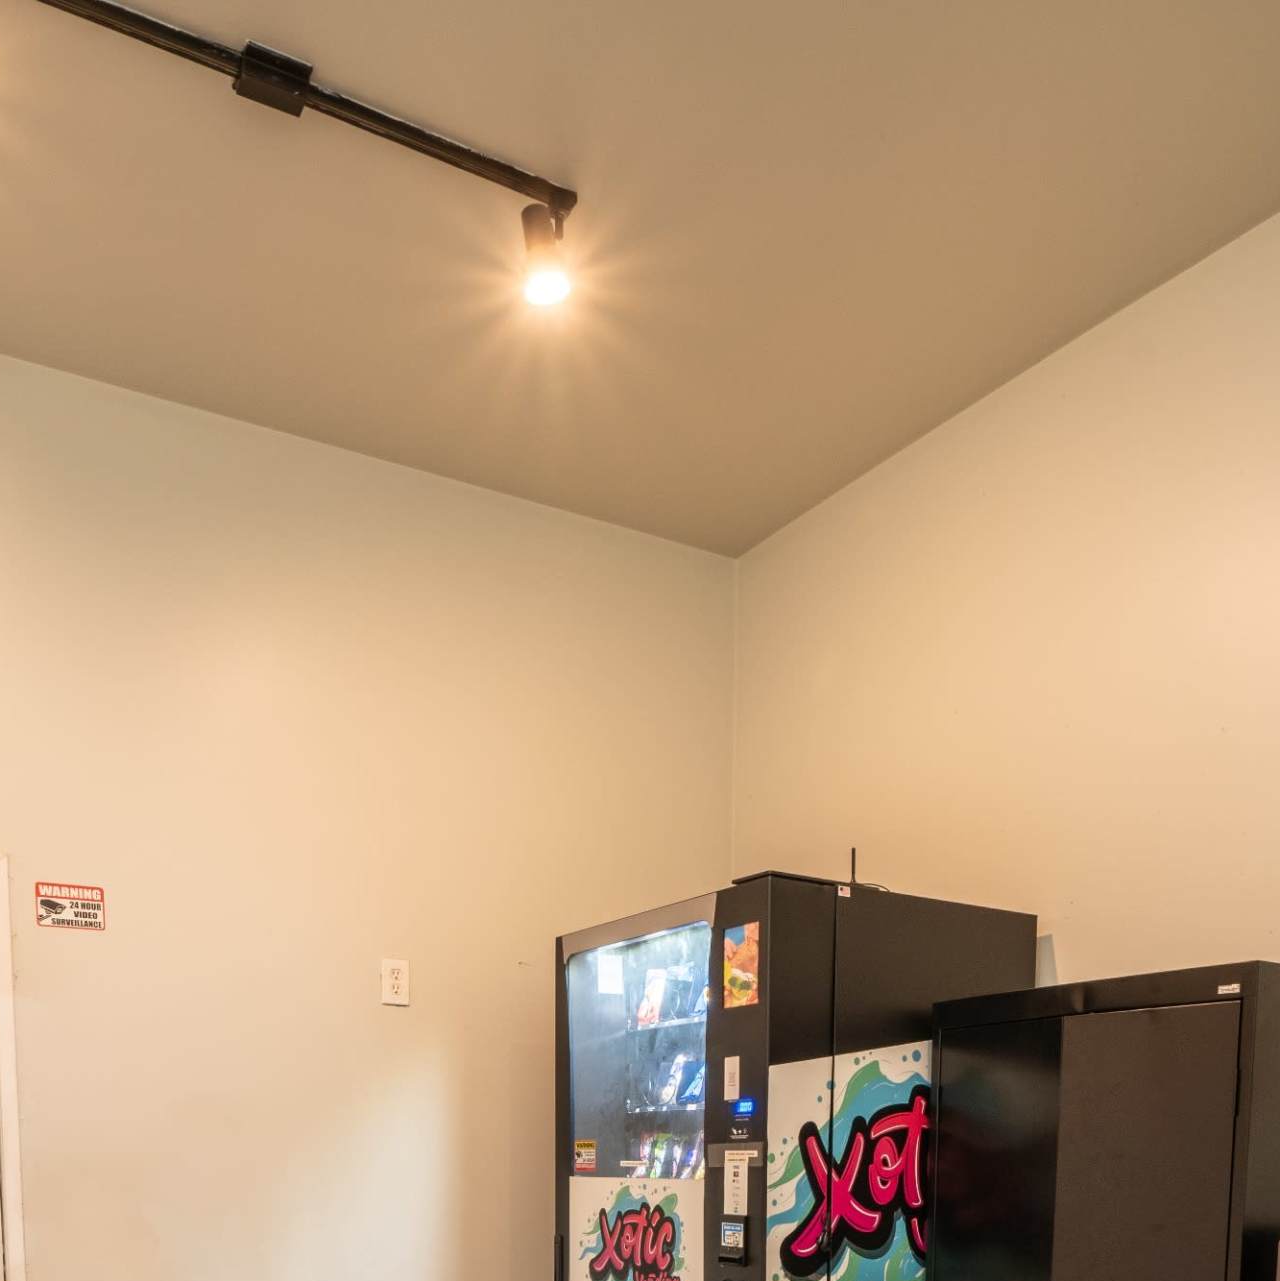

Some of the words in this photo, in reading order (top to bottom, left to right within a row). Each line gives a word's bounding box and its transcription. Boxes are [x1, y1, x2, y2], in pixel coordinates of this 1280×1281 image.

[39, 884, 101, 901] WARNING
[69, 901, 79, 909] 24
[80, 902, 102, 911] HOUR
[73, 911, 98, 920] VIDEO
[51, 917, 102, 929] SURVEILLANCE
[591, 1203, 675, 1276] Xotic
